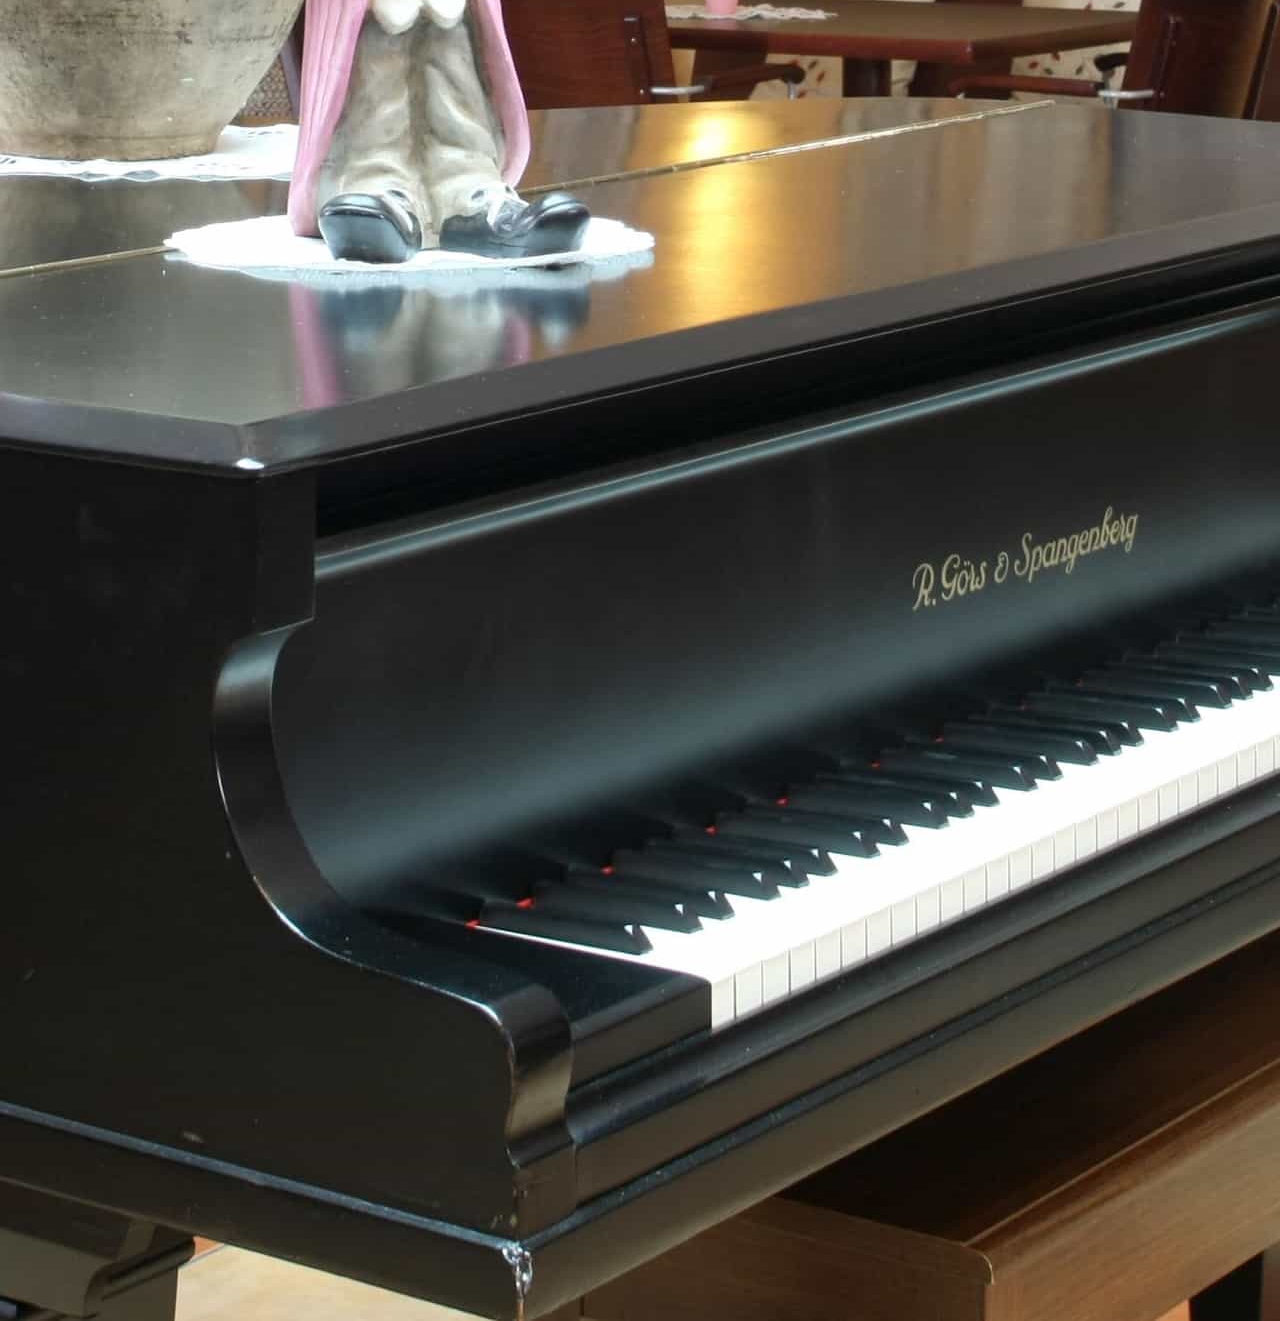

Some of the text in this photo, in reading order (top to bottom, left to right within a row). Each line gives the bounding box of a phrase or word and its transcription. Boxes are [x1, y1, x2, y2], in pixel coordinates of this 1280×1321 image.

[912, 505, 1139, 611] R. Görs & Spangenberg
